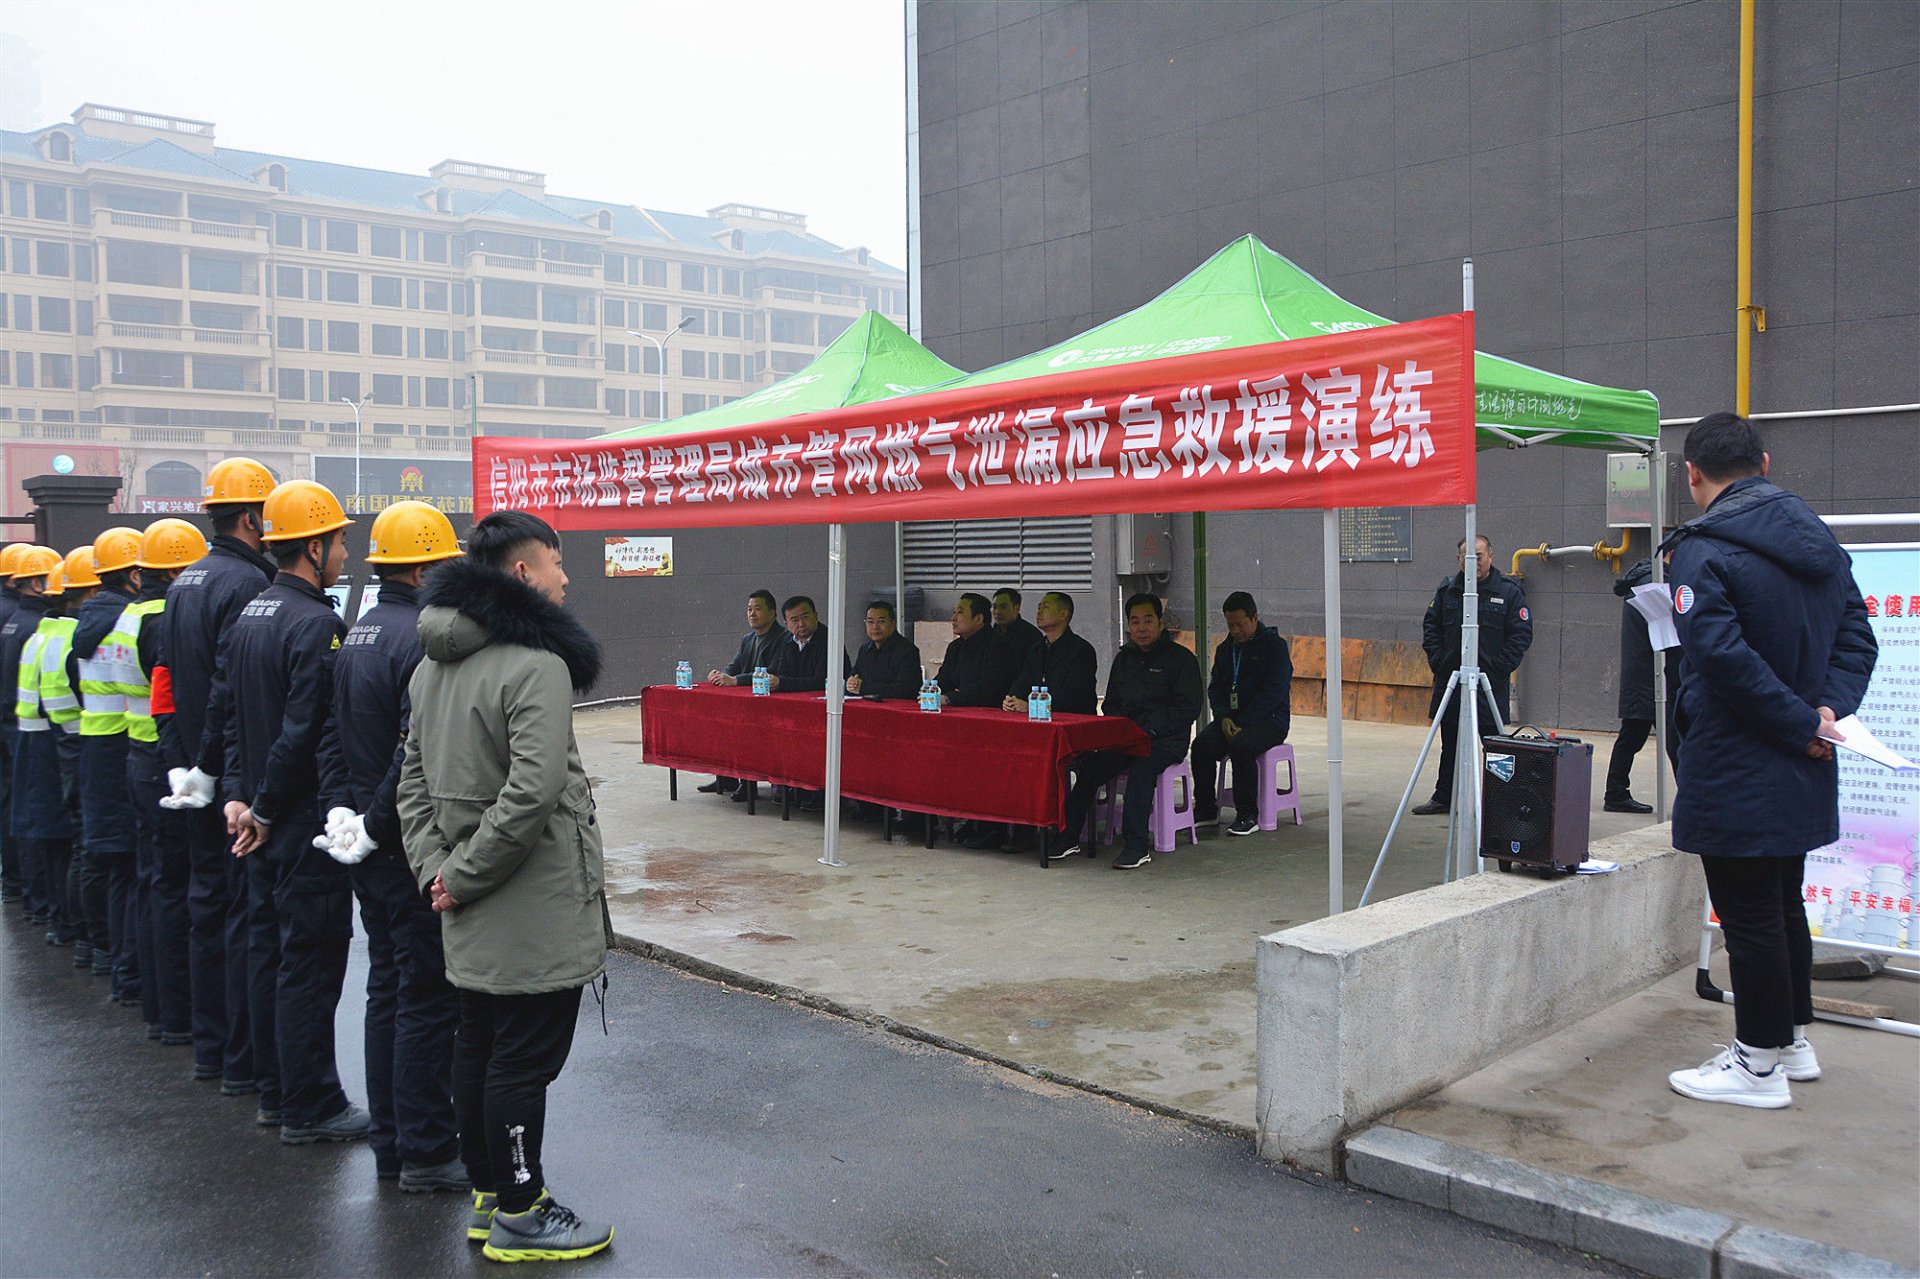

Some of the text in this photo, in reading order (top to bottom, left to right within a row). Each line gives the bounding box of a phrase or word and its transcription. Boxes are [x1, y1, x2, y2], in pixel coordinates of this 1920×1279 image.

[490, 360, 1436, 512] 信阳市市场监督管理局城市管网燃气泄漏应急救援演练
[1863, 594, 1920, 617] 全使用
